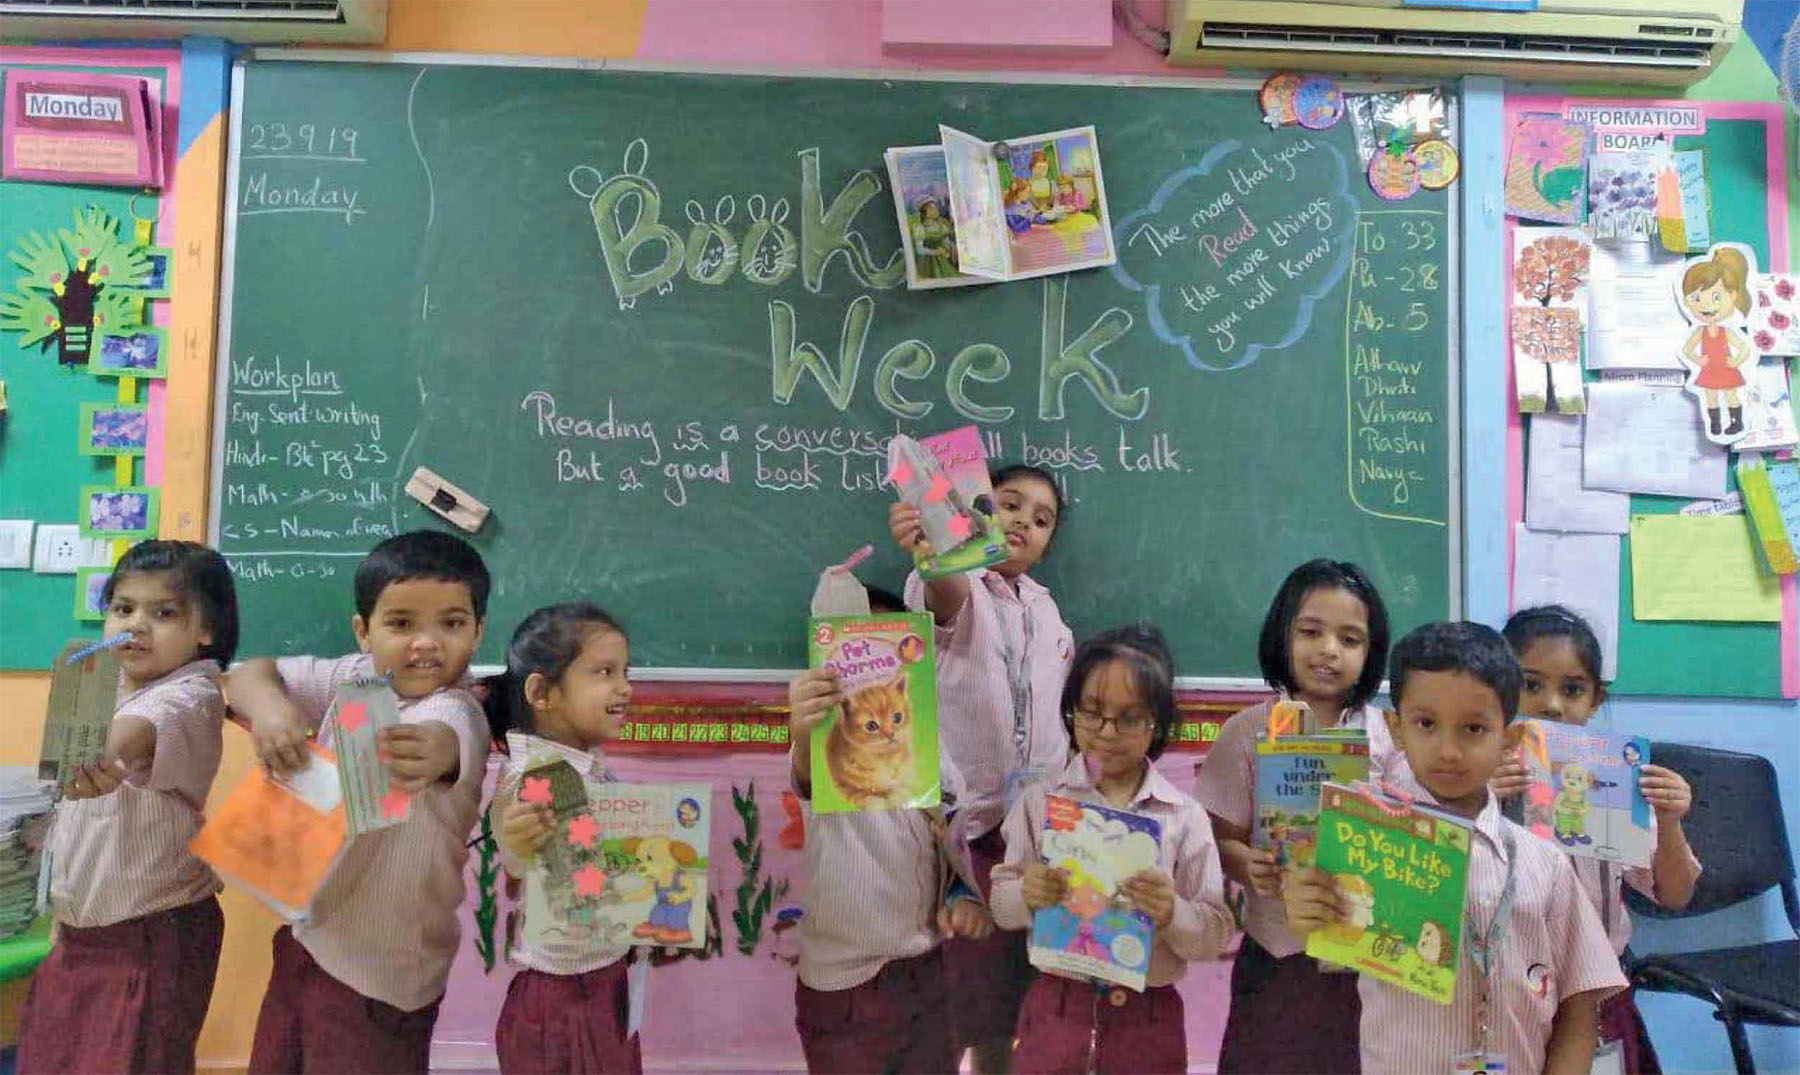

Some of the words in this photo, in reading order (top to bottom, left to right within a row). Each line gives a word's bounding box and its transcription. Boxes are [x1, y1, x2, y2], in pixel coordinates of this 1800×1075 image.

[30, 95, 118, 121] Monday
[1571, 110, 1696, 126] INFORMATION
[1603, 134, 1657, 149] BOAR
[244, 172, 358, 225] Monday
[1128, 222, 1187, 257] The
[1190, 191, 1235, 228] more
[1228, 147, 1273, 197] that
[1274, 138, 1316, 182] you
[580, 147, 903, 298] Book
[1199, 205, 1258, 270] Read
[1360, 221, 1386, 253] To
[1401, 220, 1437, 251] 33
[1180, 285, 1222, 313] the
[1226, 247, 1270, 286] more
[1267, 196, 1333, 247] things
[1208, 311, 1242, 352] you
[1244, 274, 1278, 311] will
[1405, 302, 1430, 333] 5
[768, 277, 1149, 423] Week
[232, 355, 341, 403] Workplan
[521, 390, 662, 466] Reading
[676, 421, 702, 443] is
[719, 424, 740, 443] a
[980, 430, 1004, 459] ll
[1023, 430, 1099, 464] books
[1358, 426, 1426, 454] Rashi
[354, 443, 387, 463] 23
[555, 447, 606, 483] But
[619, 466, 637, 485] a
[664, 449, 730, 507] good
[756, 451, 822, 484] book
[820, 627, 832, 644] 2
[841, 638, 871, 660] Pet
[1336, 820, 1367, 847] Do
[1369, 828, 1406, 858] You
[1409, 842, 1453, 879] Like
[1347, 847, 1379, 874] My
[1381, 857, 1441, 896] Bike?
